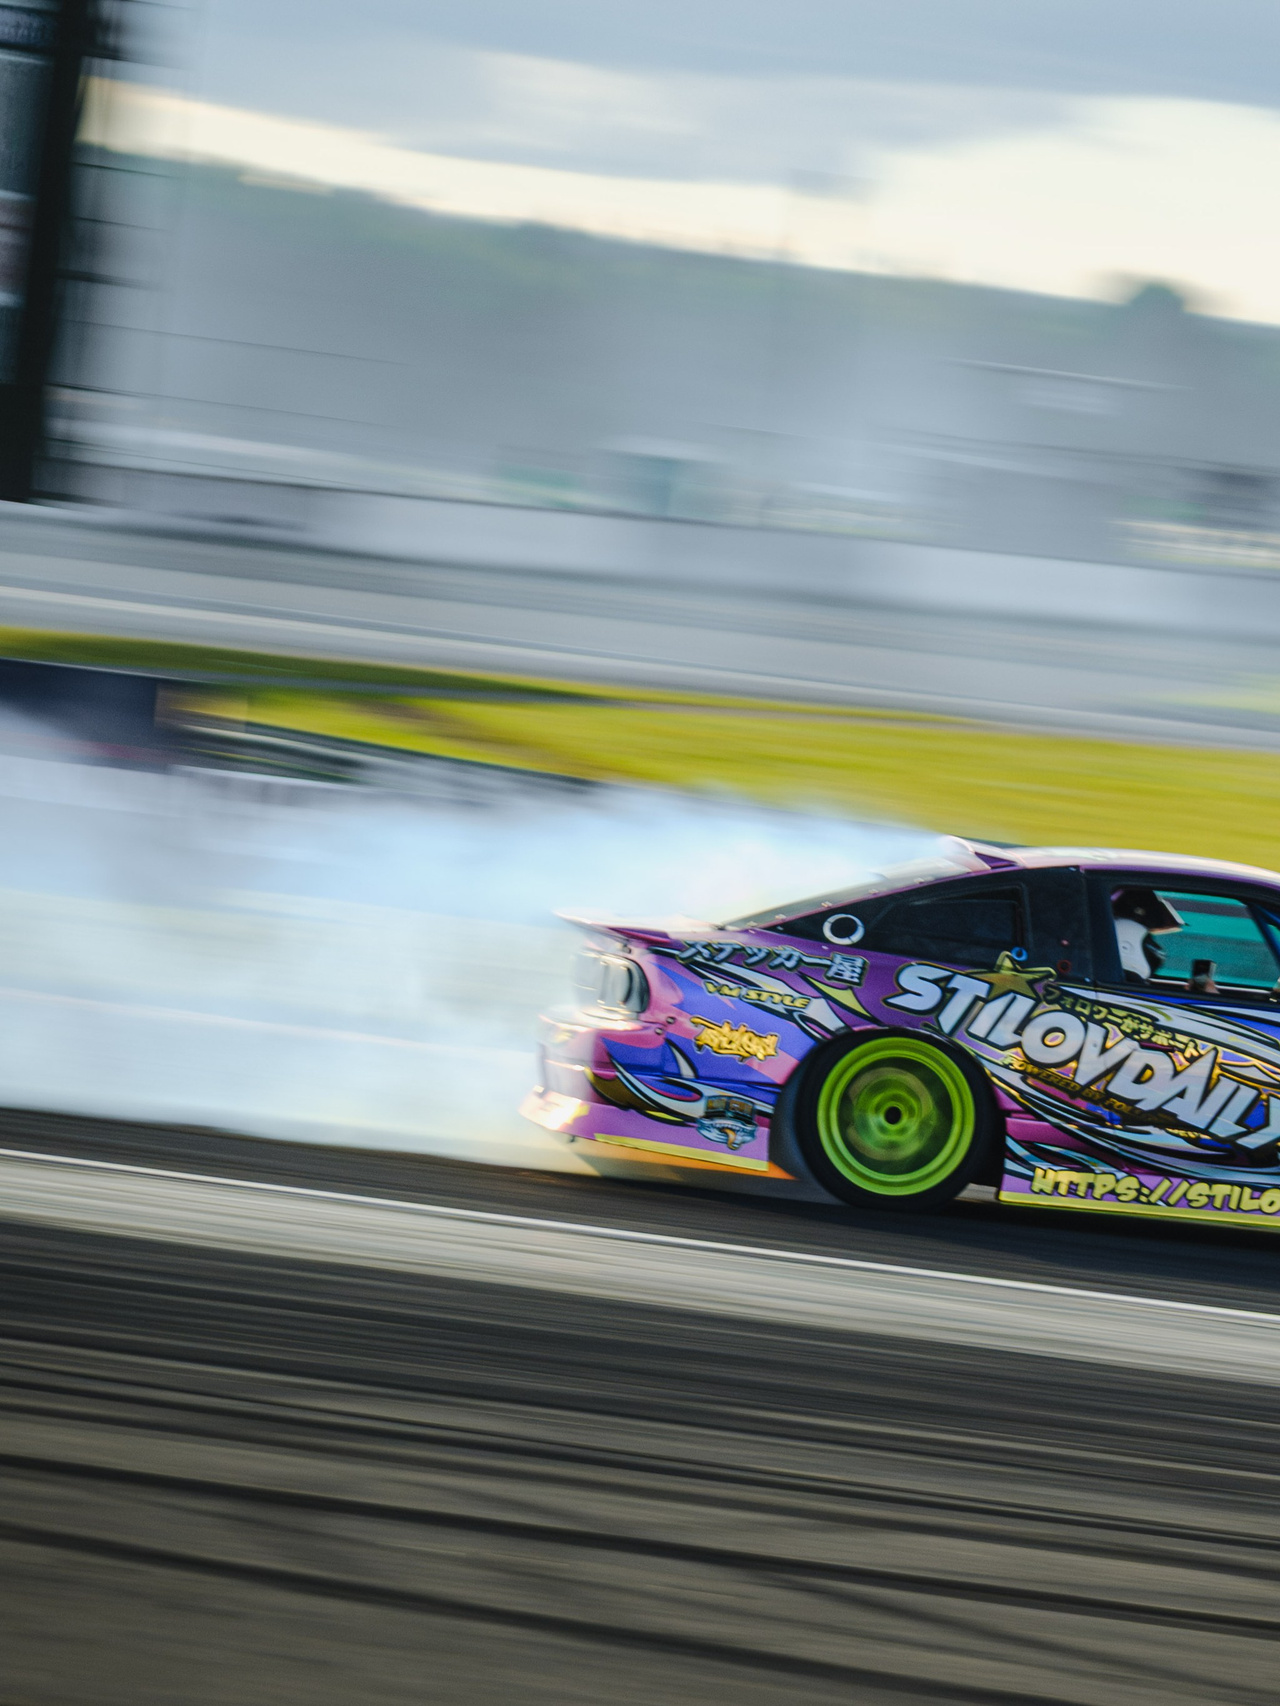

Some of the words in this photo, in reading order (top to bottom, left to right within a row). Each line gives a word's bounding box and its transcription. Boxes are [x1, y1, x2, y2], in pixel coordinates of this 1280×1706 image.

[677, 939, 866, 985] ステッカー屋
[744, 988, 812, 1009] STYLE
